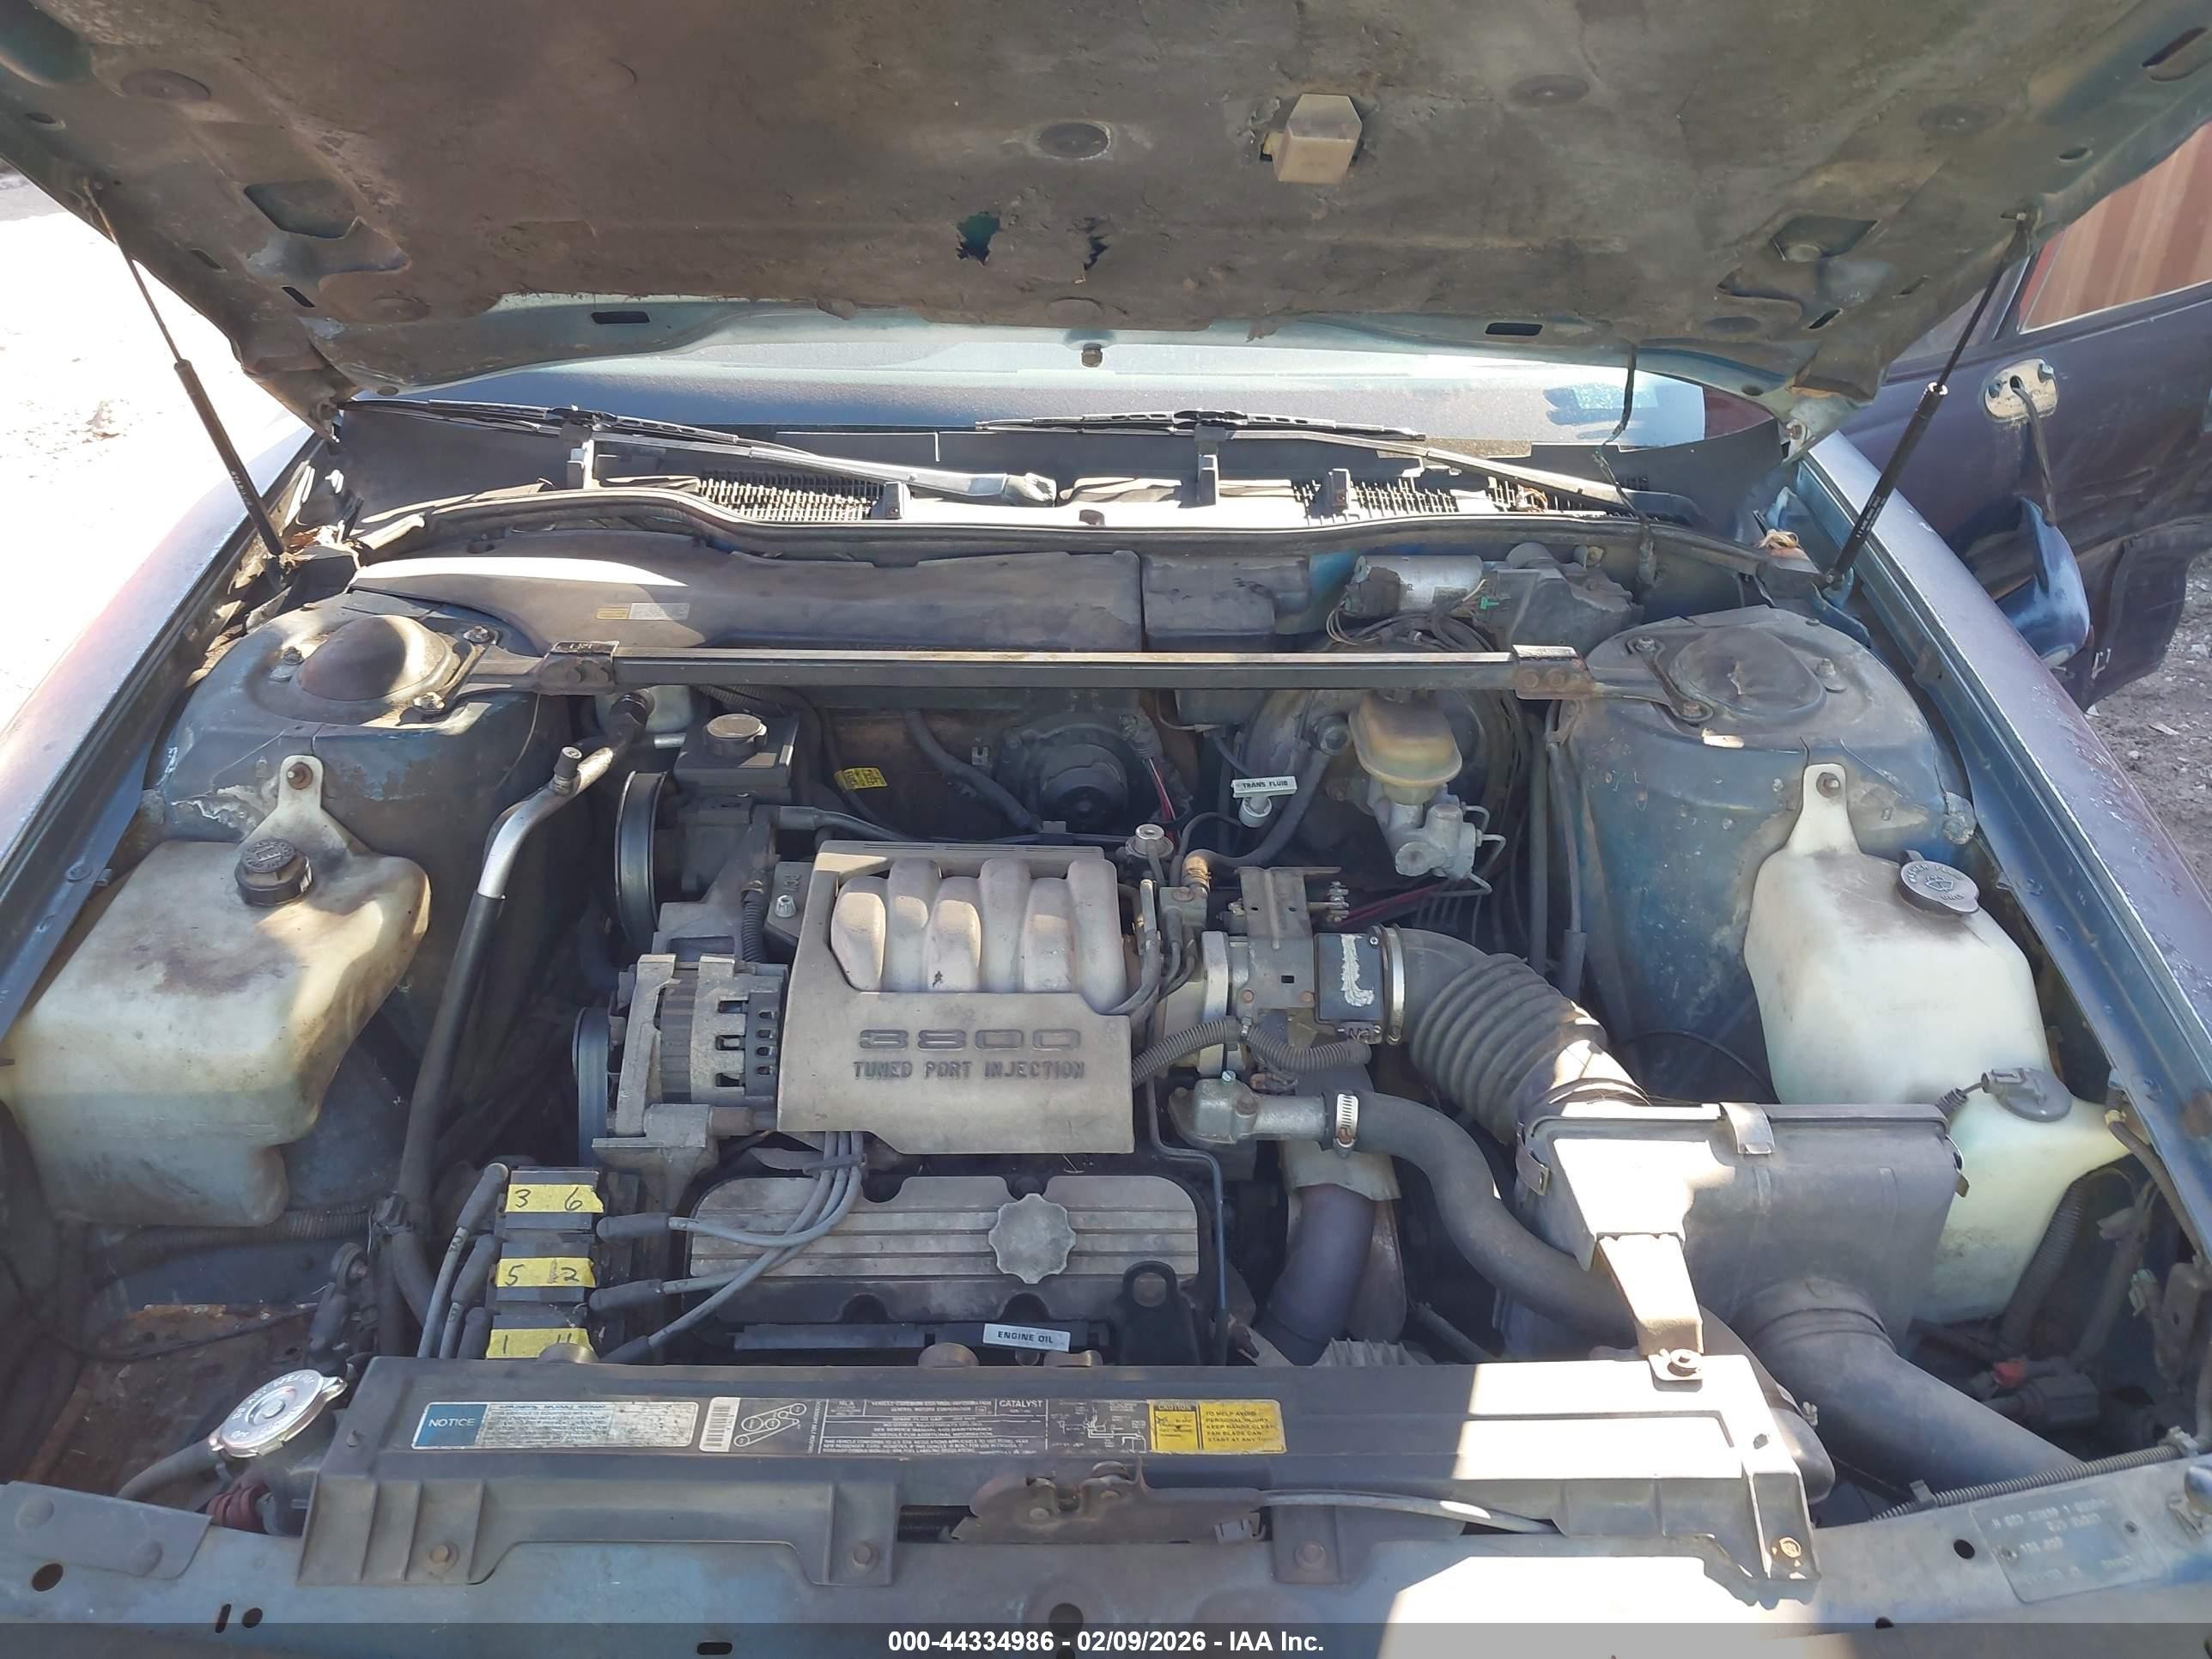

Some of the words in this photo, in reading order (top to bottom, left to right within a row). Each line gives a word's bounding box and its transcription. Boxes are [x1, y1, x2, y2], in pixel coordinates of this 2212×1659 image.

[859, 1030, 1082, 1050] 3800
[853, 1060, 913, 1079] TUNED
[924, 1060, 972, 1079] PORT
[984, 1060, 1085, 1079] INJECTION
[514, 1188, 532, 1208] 3
[564, 1187, 583, 1211] 6
[505, 1264, 526, 1286] 5
[562, 1267, 580, 1282] 2
[997, 1331, 1035, 1341] ENGINE
[999, 1400, 1043, 1408] CATALYST
[428, 1418, 475, 1427] NOTICE
